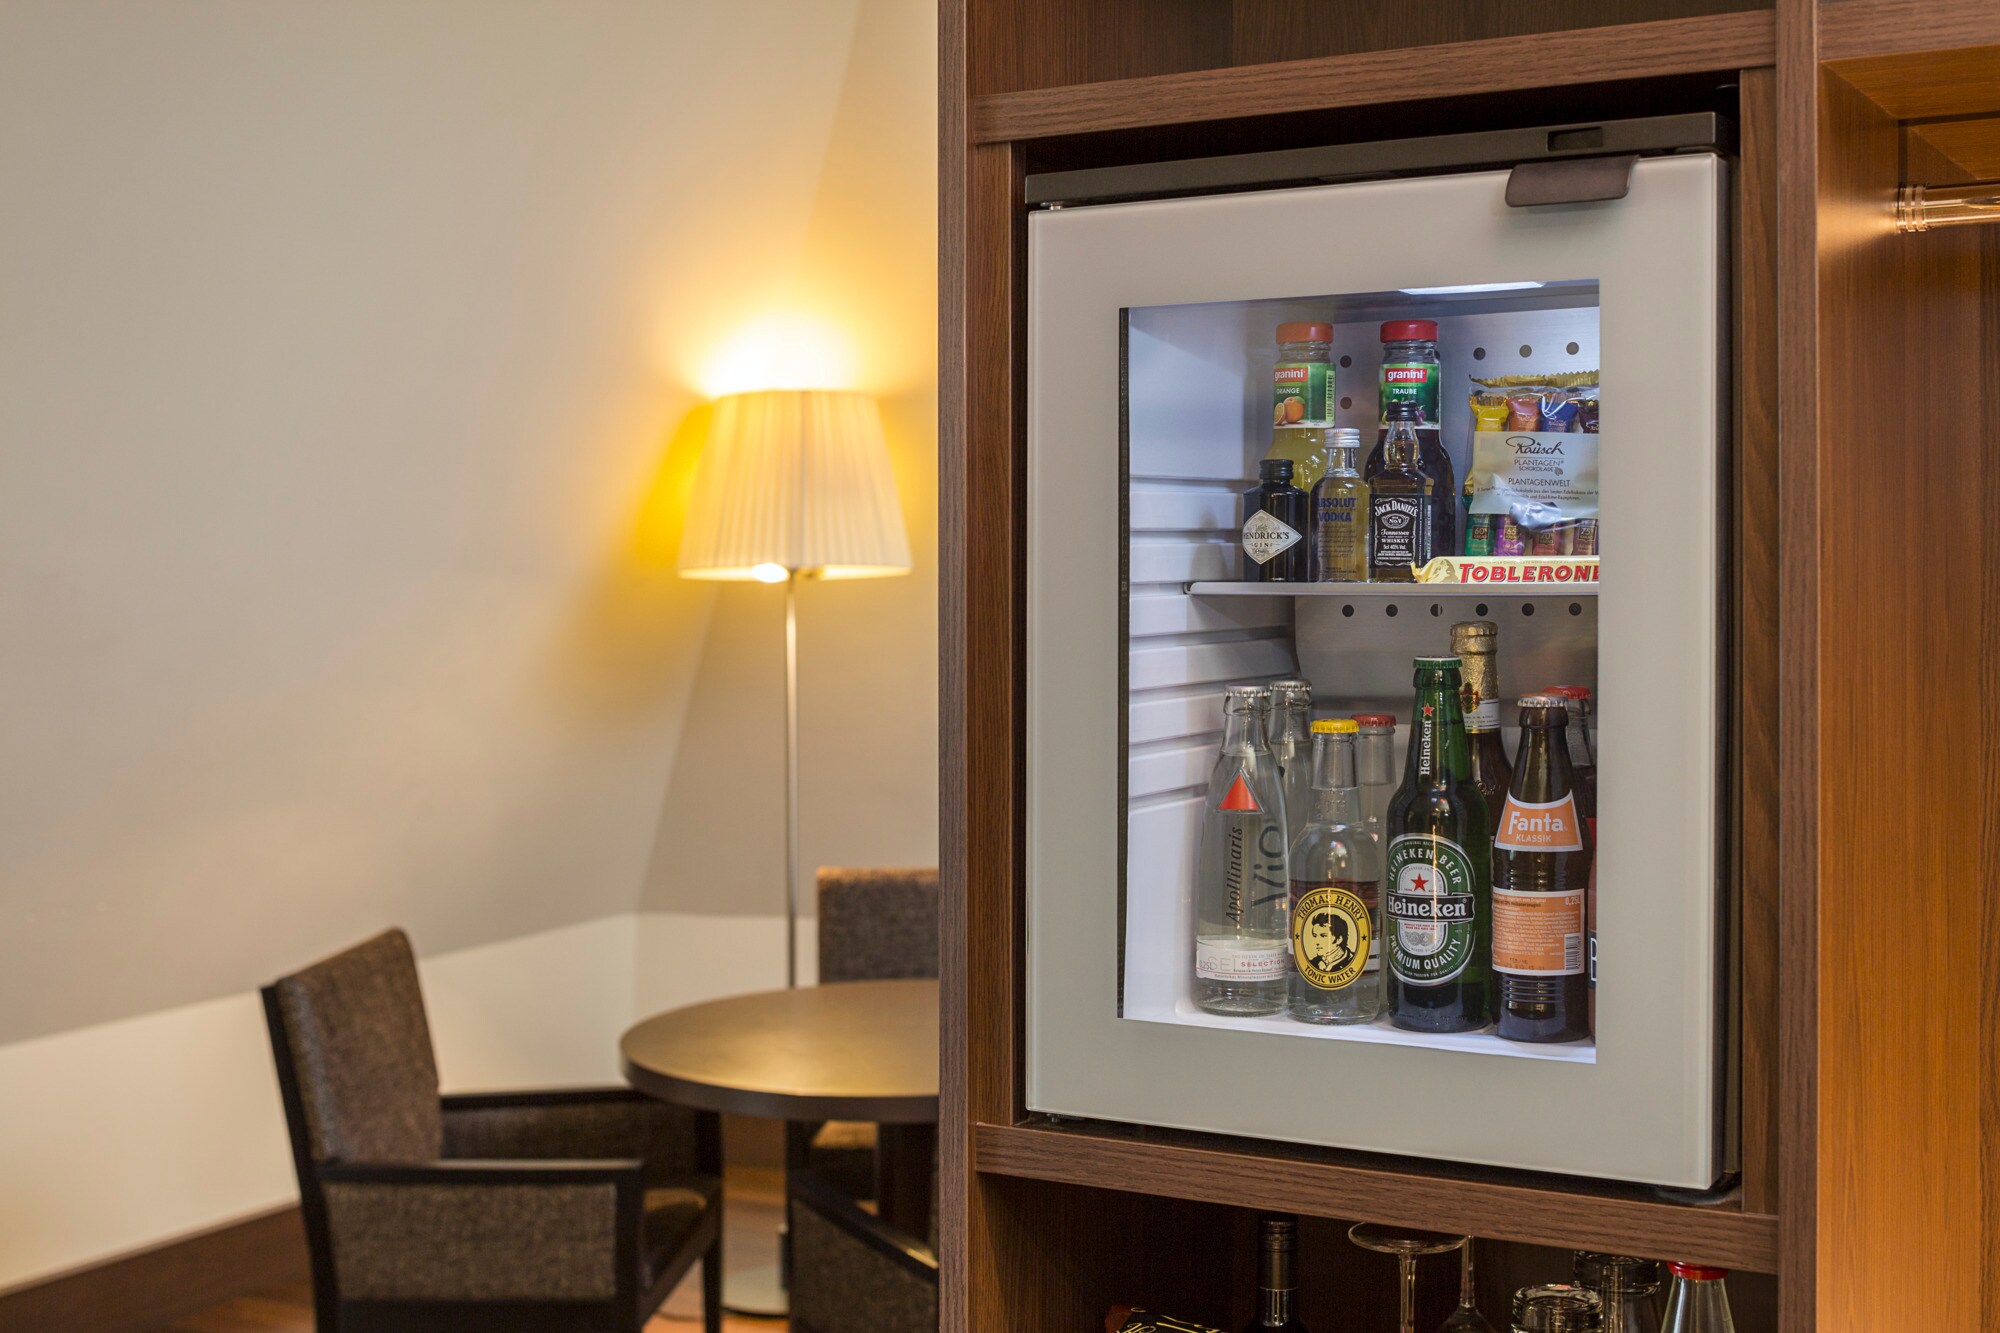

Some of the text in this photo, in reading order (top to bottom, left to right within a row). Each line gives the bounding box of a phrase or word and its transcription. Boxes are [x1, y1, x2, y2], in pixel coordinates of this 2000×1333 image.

[1274, 369, 1304, 381] granini
[1388, 369, 1423, 381] granini
[1508, 478, 1570, 487] PLANTAGENWELT
[1317, 497, 1356, 508] ABSOLUT
[1374, 503, 1391, 516] JACK
[1318, 512, 1352, 522] VODKA
[1420, 720, 1432, 776] Heineken
[1507, 811, 1564, 835] Fanta
[1515, 833, 1552, 843] KLASSIK
[1225, 826, 1244, 923] Apollinaris
[1389, 848, 1434, 881] HEINEKEN
[1439, 854, 1461, 885] BEER
[1297, 895, 1365, 921] THOMAS HENRY
[1387, 896, 1466, 917] Heineken
[1389, 935, 1461, 970] PREMIUM QUALITY
[1304, 965, 1356, 983] TONIC WATER
